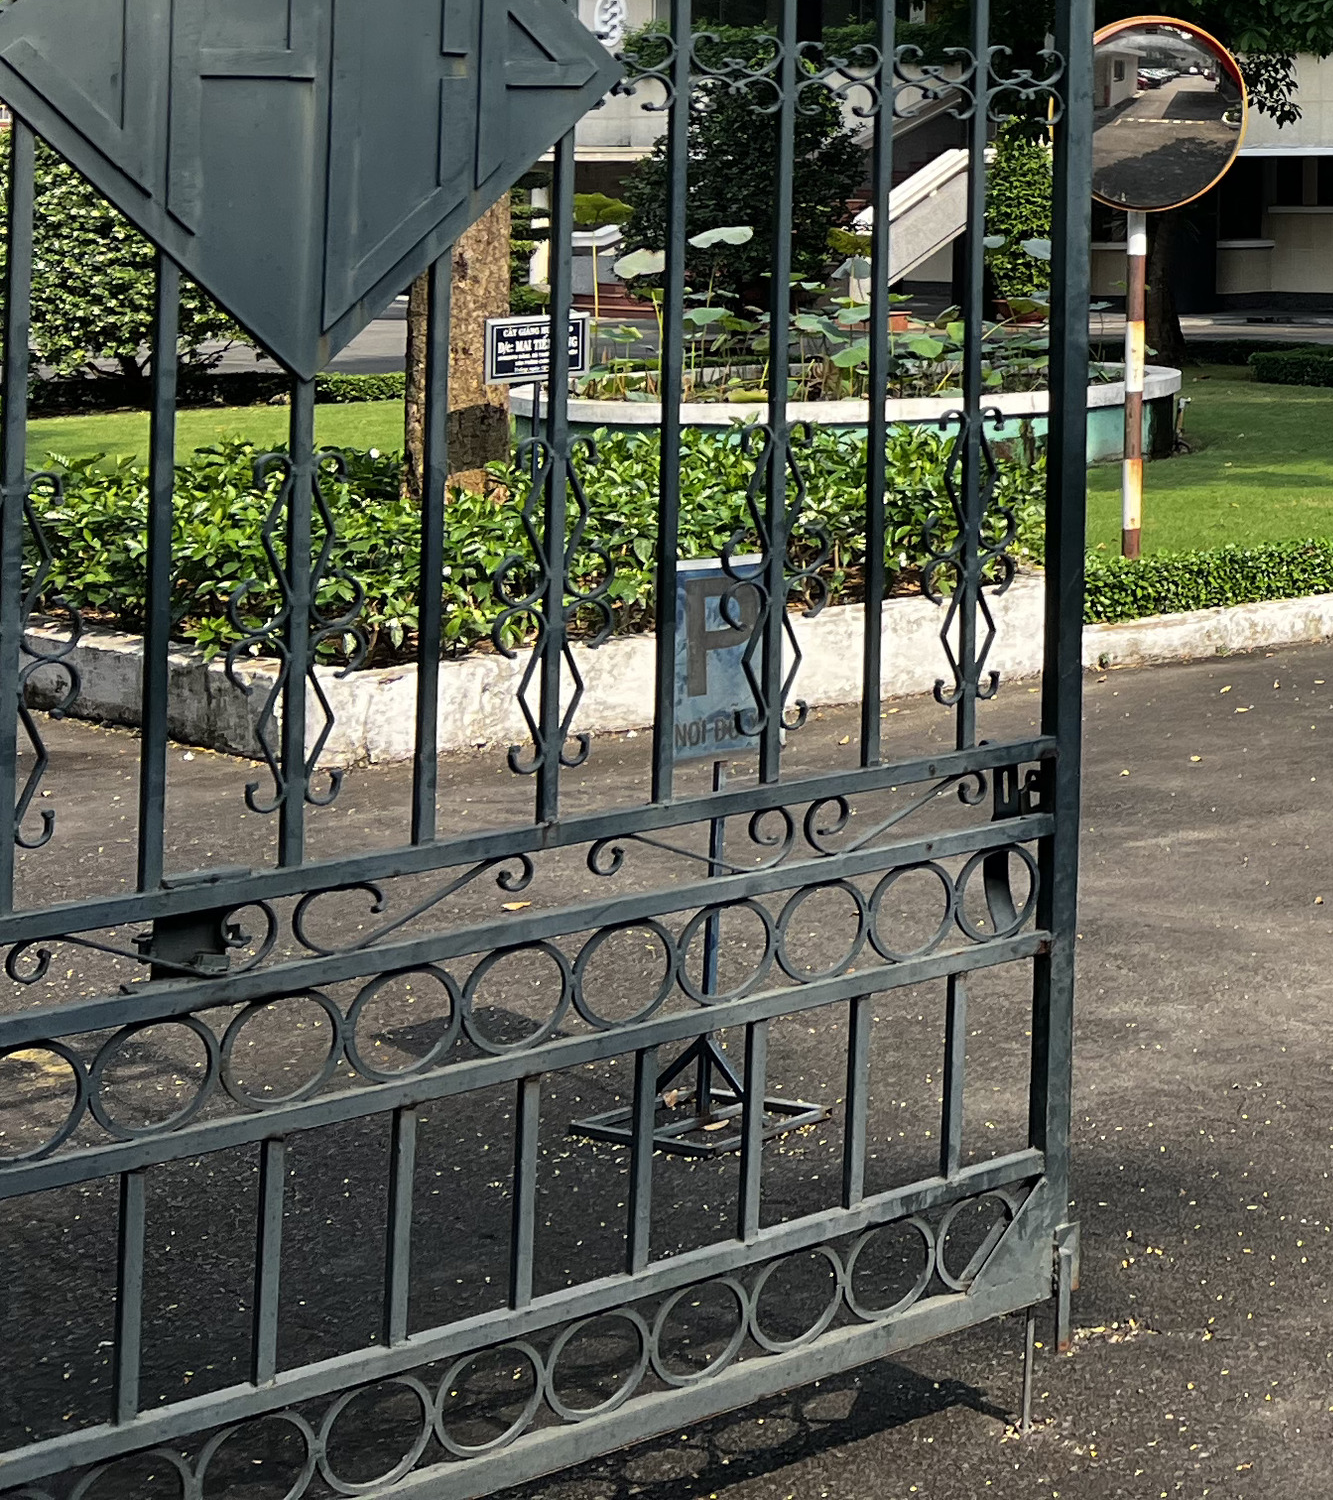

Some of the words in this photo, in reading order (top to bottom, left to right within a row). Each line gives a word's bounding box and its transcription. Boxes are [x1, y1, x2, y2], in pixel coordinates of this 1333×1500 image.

[515, 339, 532, 352] MAI
[534, 333, 550, 351] TIẾ
[686, 576, 762, 698] P
